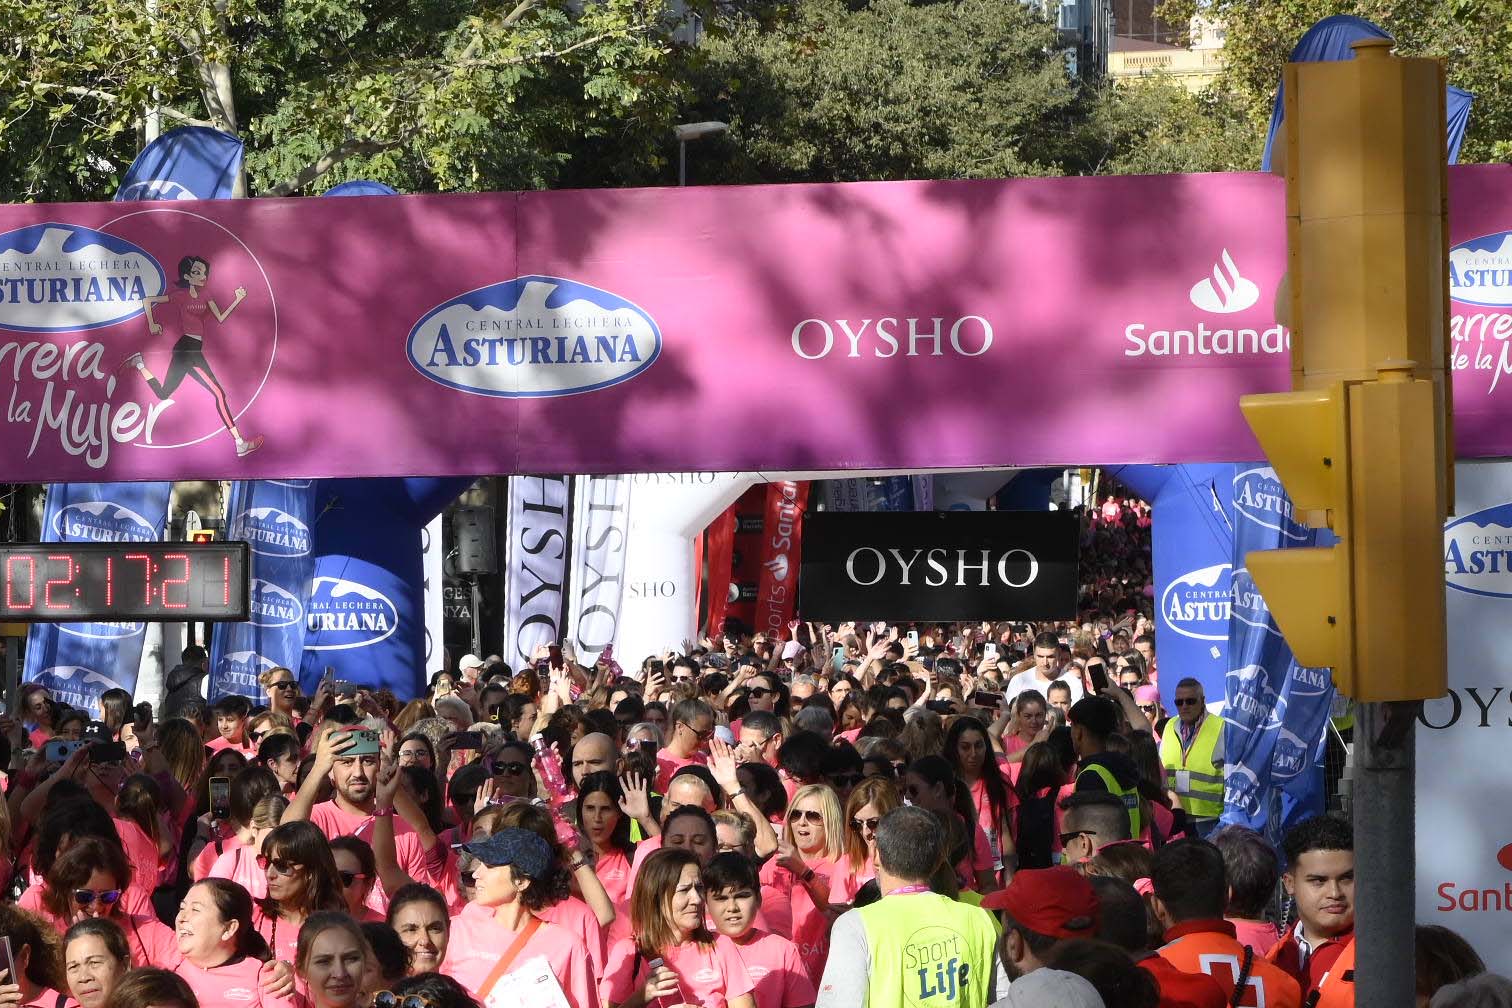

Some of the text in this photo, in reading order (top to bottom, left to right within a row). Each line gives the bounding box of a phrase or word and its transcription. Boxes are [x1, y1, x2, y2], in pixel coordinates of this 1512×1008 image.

[69, 260, 141, 270] LECHERA
[1465, 257, 1512, 266] CENTRA
[465, 317, 633, 331] CENTRAL LECHERA
[791, 315, 994, 359] OYSHO
[1124, 322, 1291, 357] Santand
[1450, 313, 1512, 342] arre
[426, 323, 642, 368] ASTURIANA
[1475, 341, 1492, 370] la
[7, 383, 32, 424] la
[25, 375, 175, 470] Mujer
[772, 481, 798, 551] Santa
[1239, 480, 1295, 519] ASTUR
[1445, 538, 1512, 574] ASTU
[1472, 535, 1512, 545] CENT
[6, 554, 230, 608] 02:17:21
[517, 475, 565, 665] OYSH
[577, 475, 623, 653] OYSH
[846, 547, 1039, 588] OYSHO
[336, 601, 385, 611] LECHERA
[631, 581, 676, 598] SHO
[1168, 592, 1231, 621] ASTU
[308, 612, 389, 632] URIANA
[443, 605, 472, 618] NYA
[1436, 882, 1512, 912] Sant
[905, 934, 961, 970] Sport
[918, 957, 970, 1000] Life
